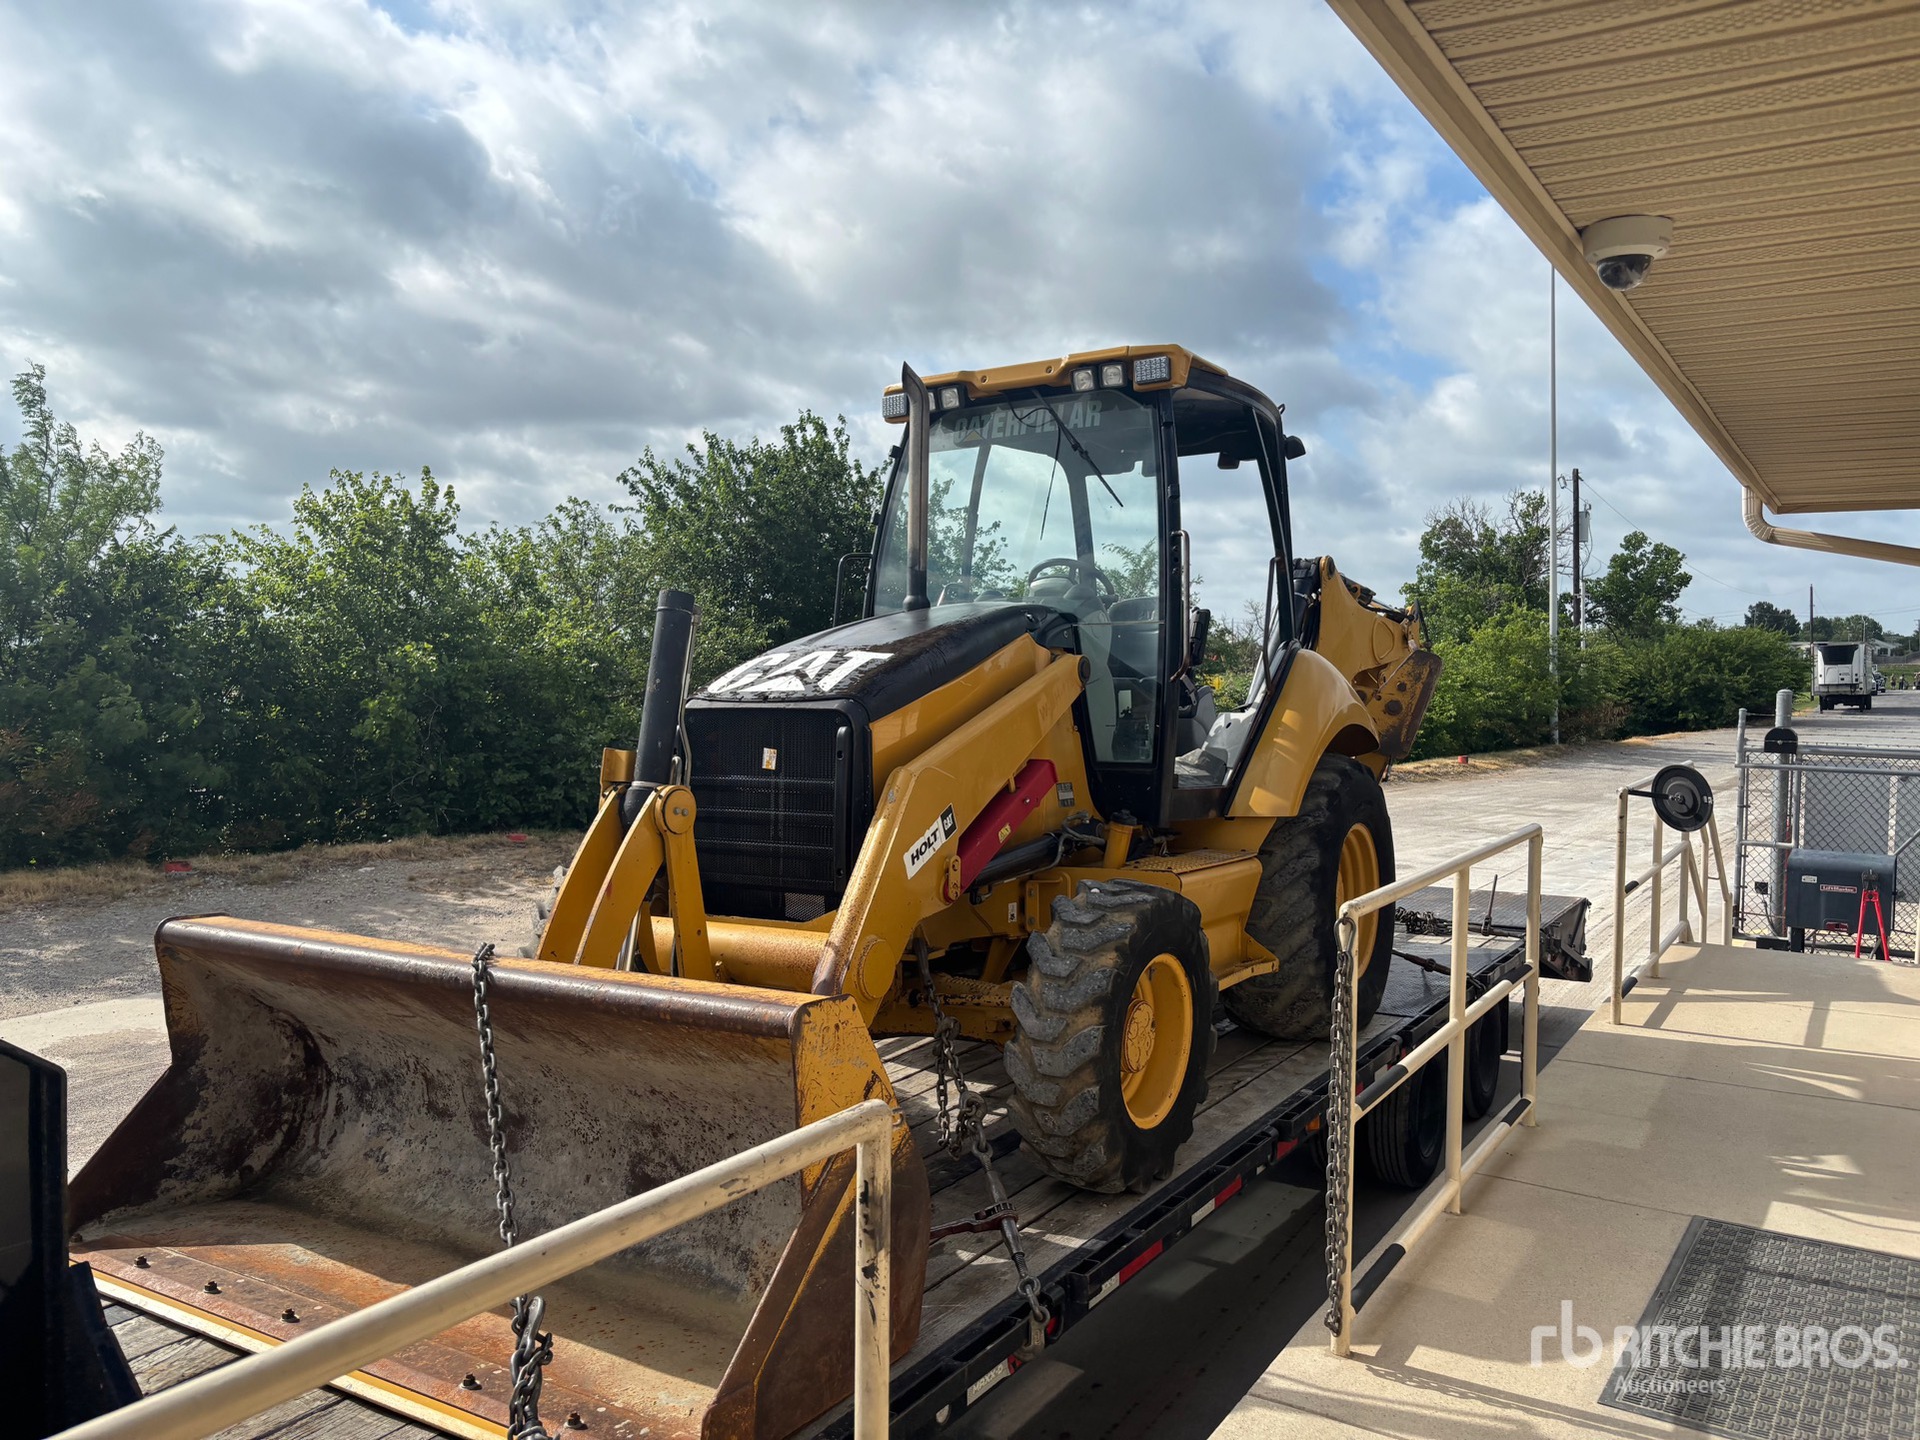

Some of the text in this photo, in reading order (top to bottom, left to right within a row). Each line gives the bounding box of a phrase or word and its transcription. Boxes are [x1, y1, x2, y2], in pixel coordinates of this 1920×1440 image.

[954, 400, 1102, 442] CATERPILLAR
[707, 650, 894, 693] CAT
[910, 828, 938, 866] HOLT
